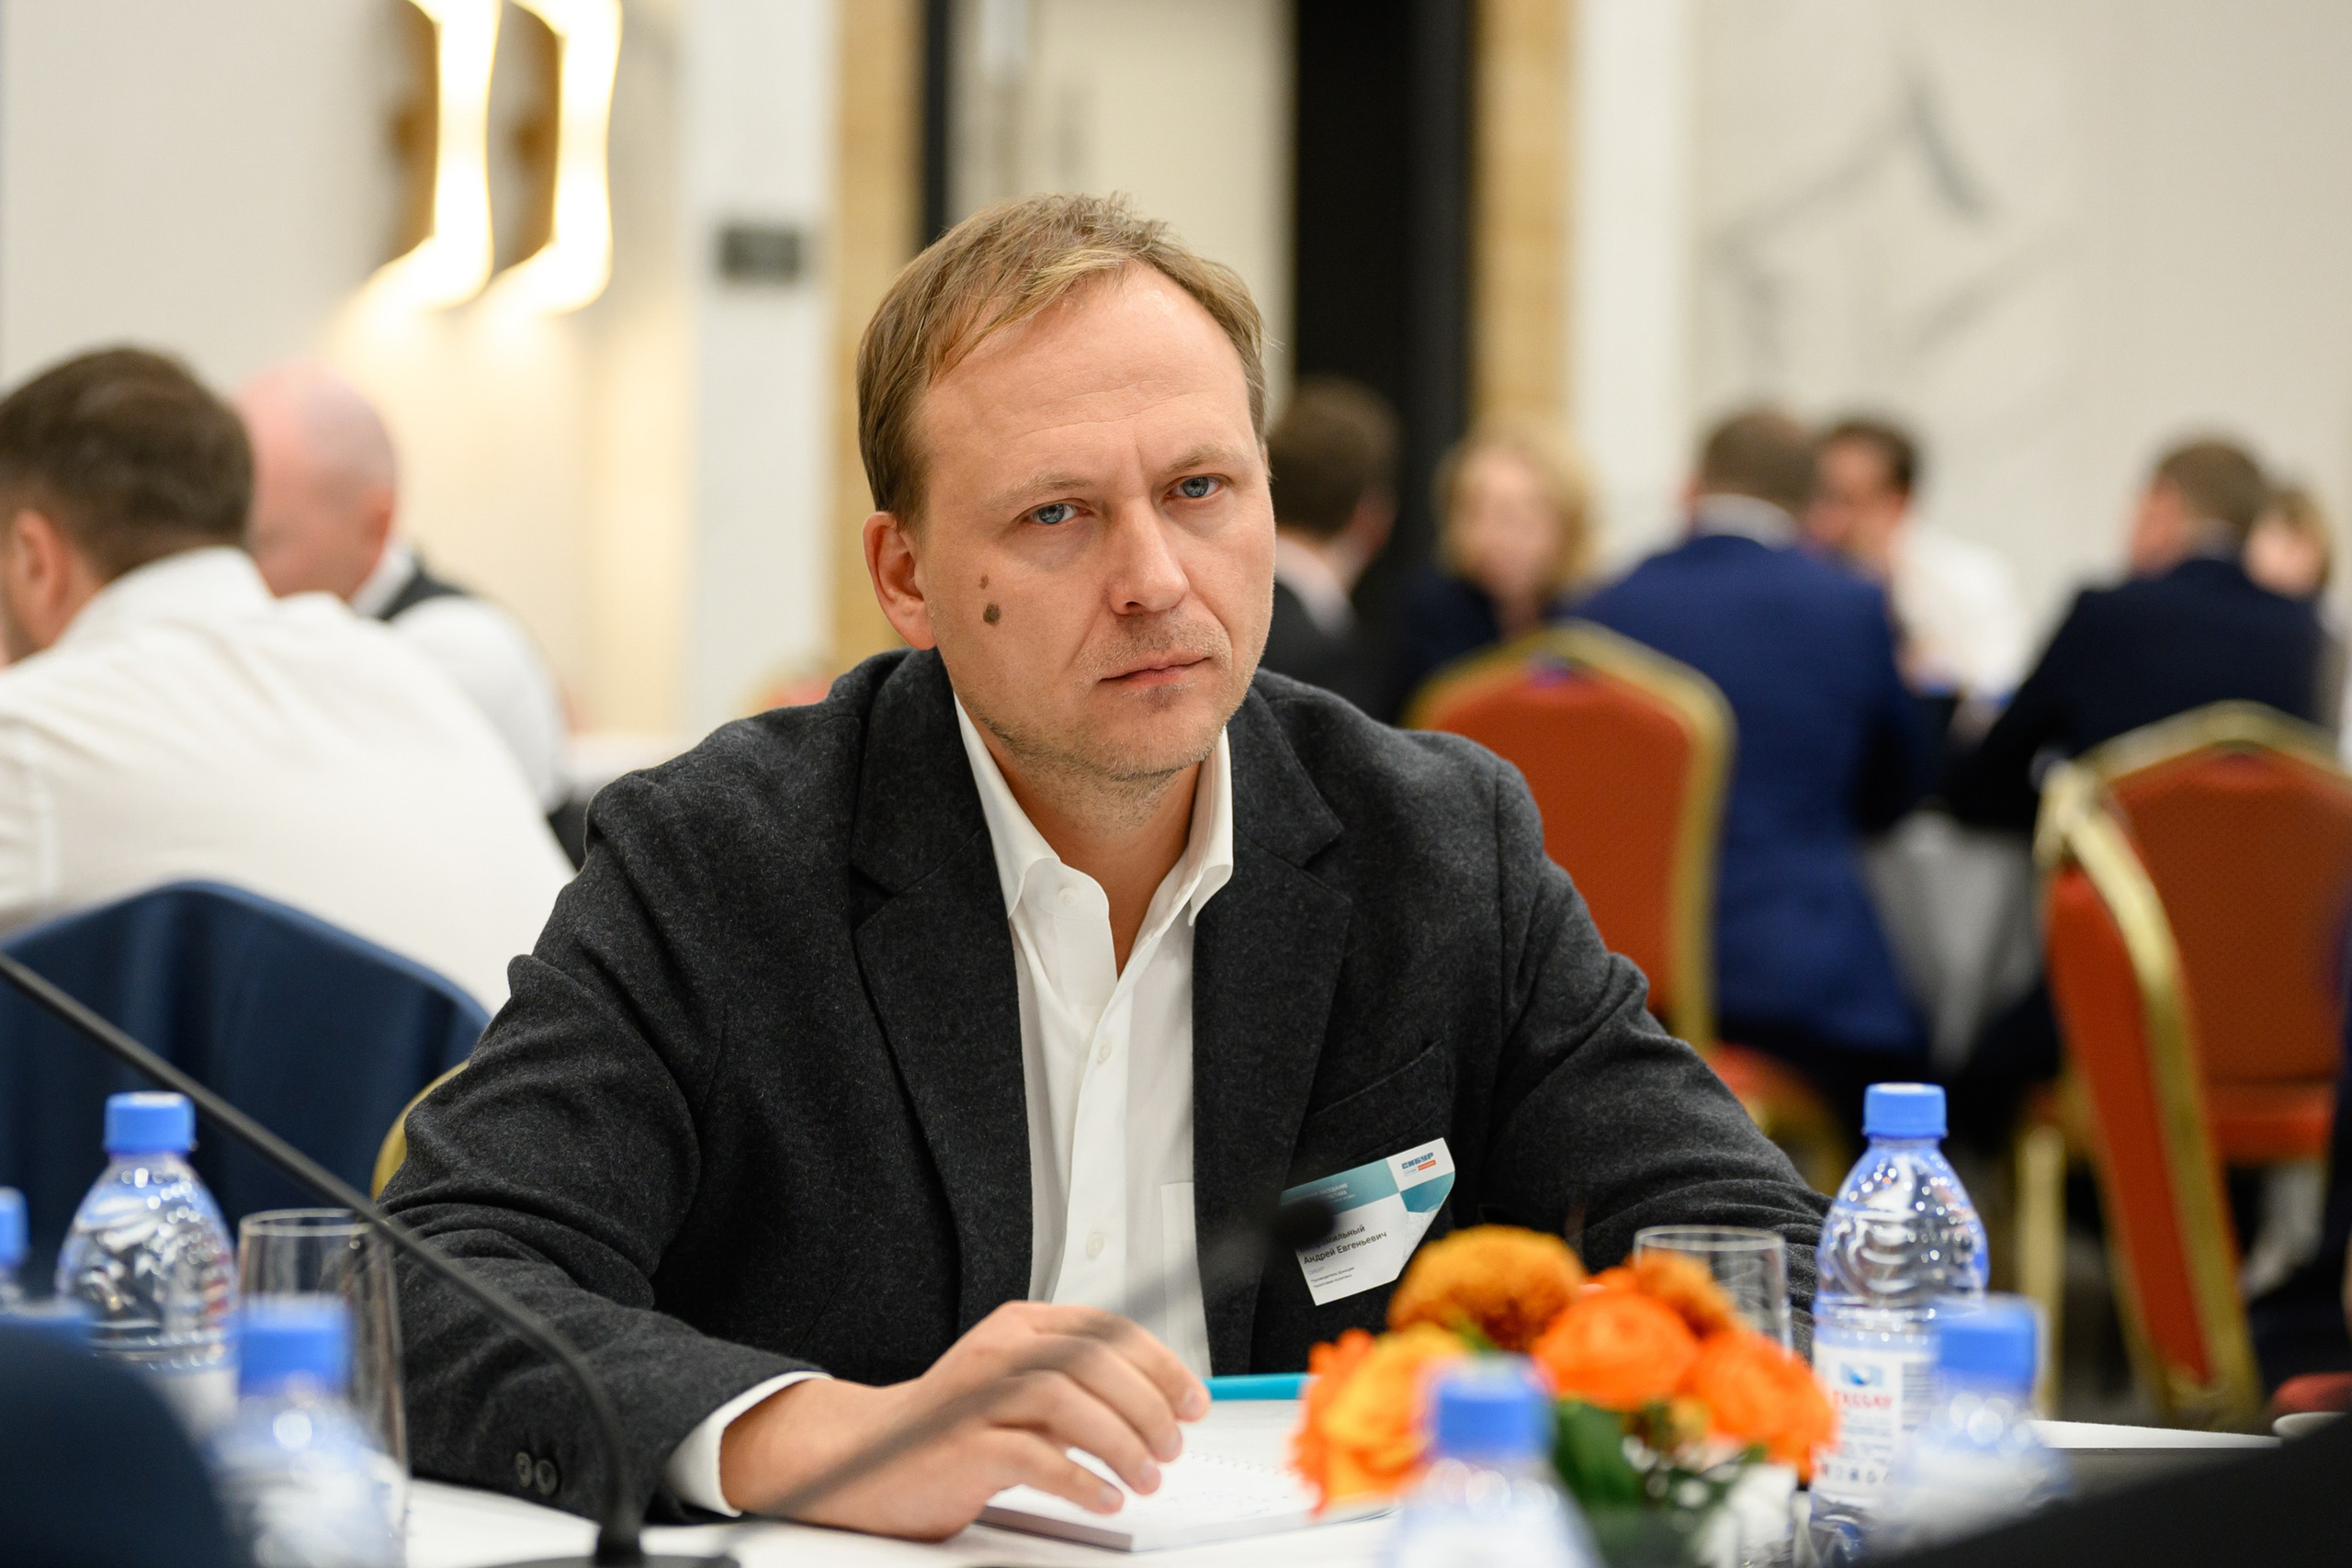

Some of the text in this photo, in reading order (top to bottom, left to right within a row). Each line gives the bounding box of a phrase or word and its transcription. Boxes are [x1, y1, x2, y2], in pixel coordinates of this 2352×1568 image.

[1401, 1152, 1434, 1170] СИБУР
[1304, 1231, 1387, 1265] Андрей Евгеньевич
